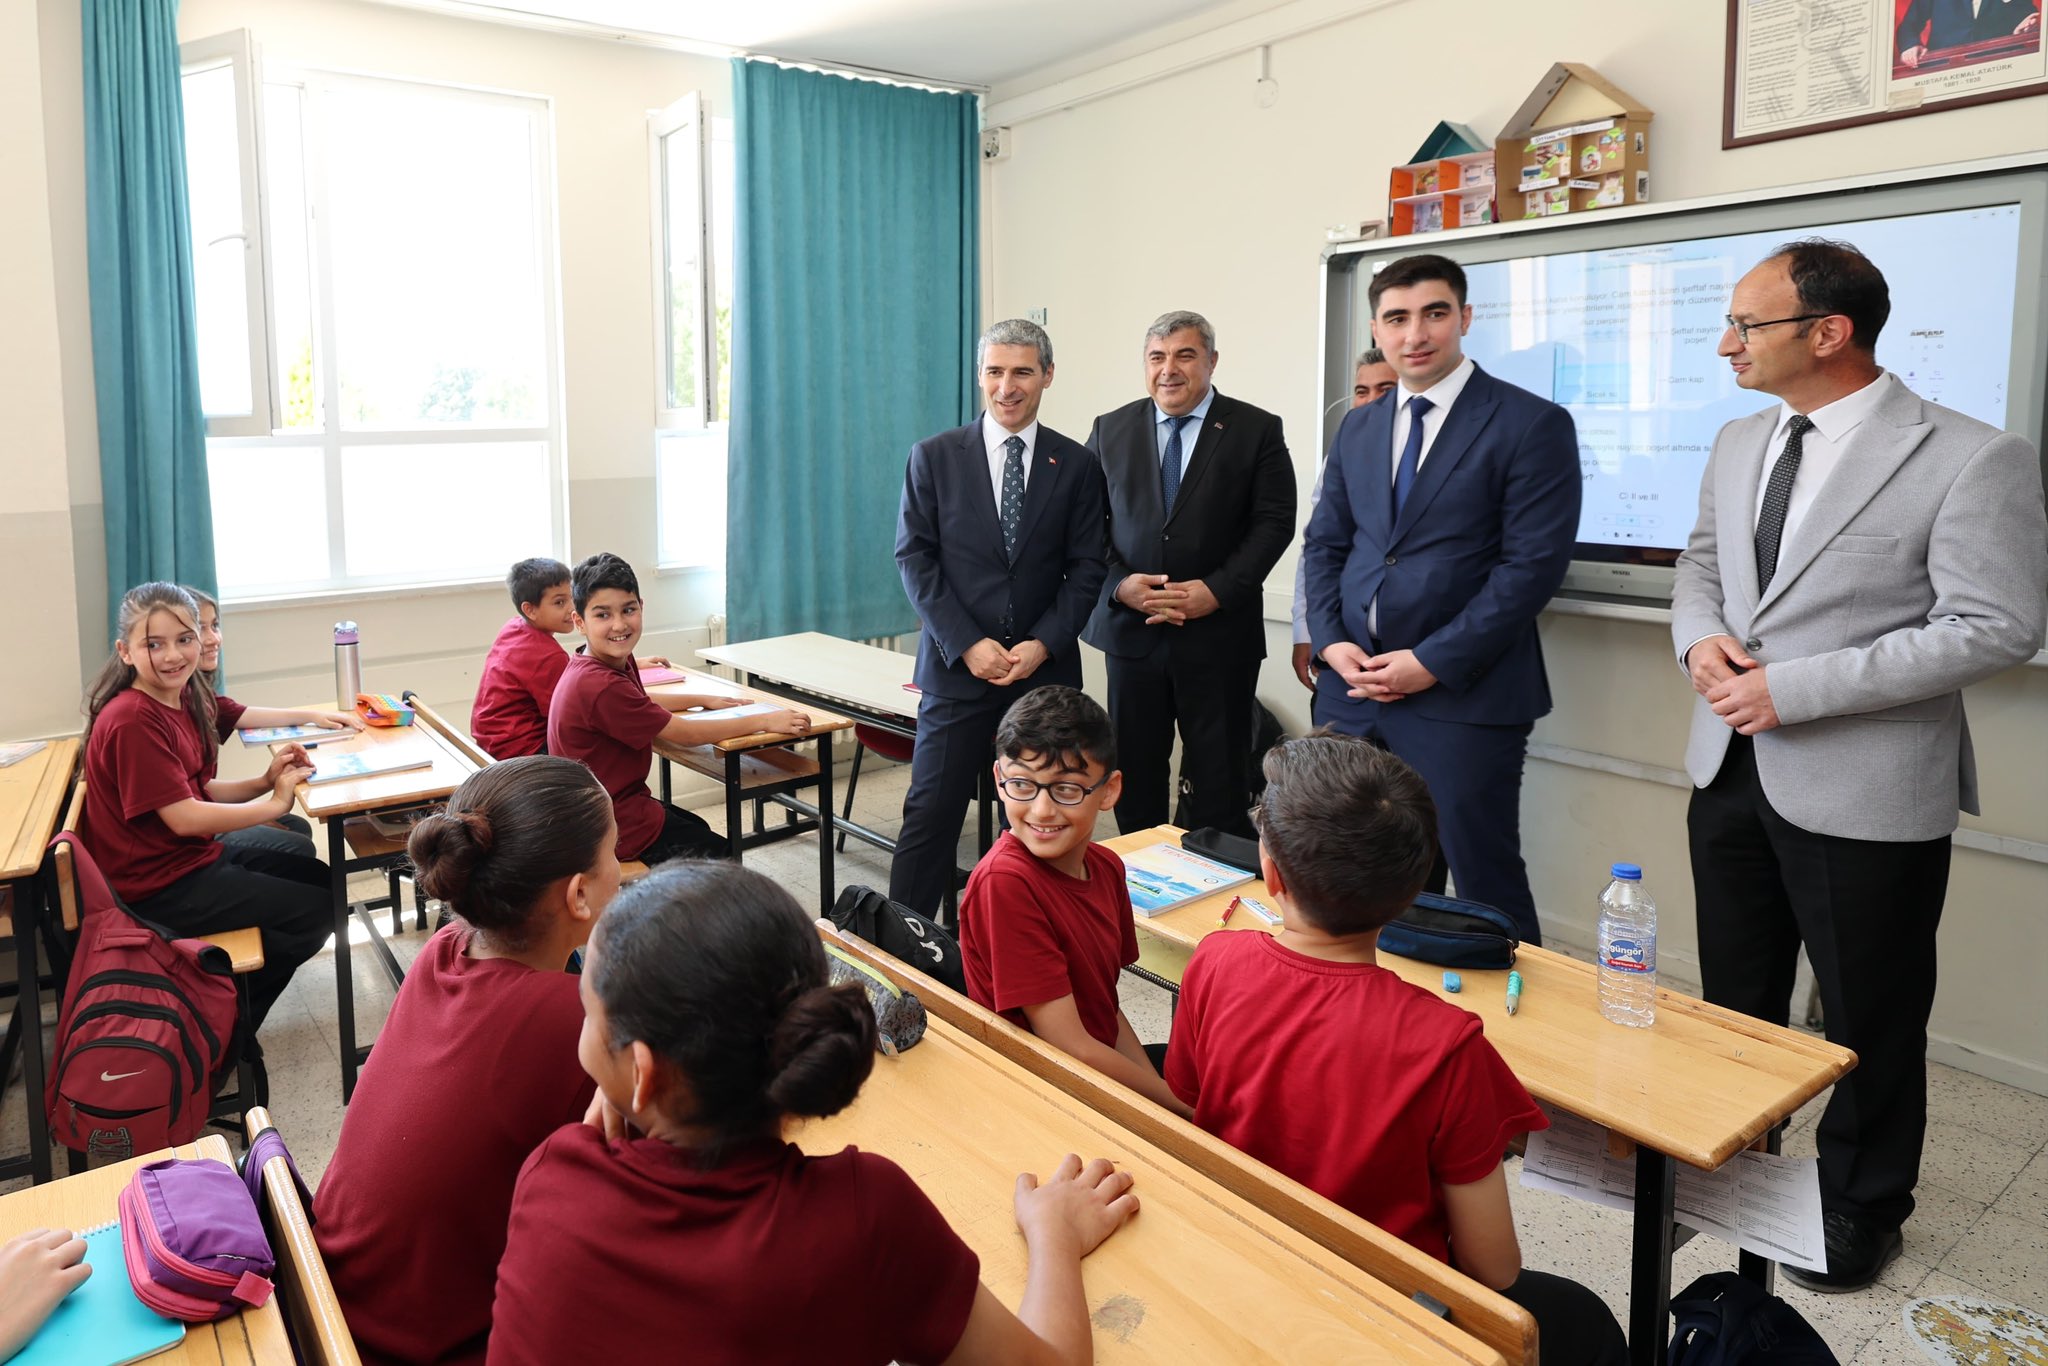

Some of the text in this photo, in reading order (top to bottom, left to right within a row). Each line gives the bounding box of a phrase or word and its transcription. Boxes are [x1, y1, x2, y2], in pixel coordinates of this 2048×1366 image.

[1914, 63, 2014, 87] MUSTAFA KEMAL ATATÜRK
[1609, 944, 1643, 956] güngör
